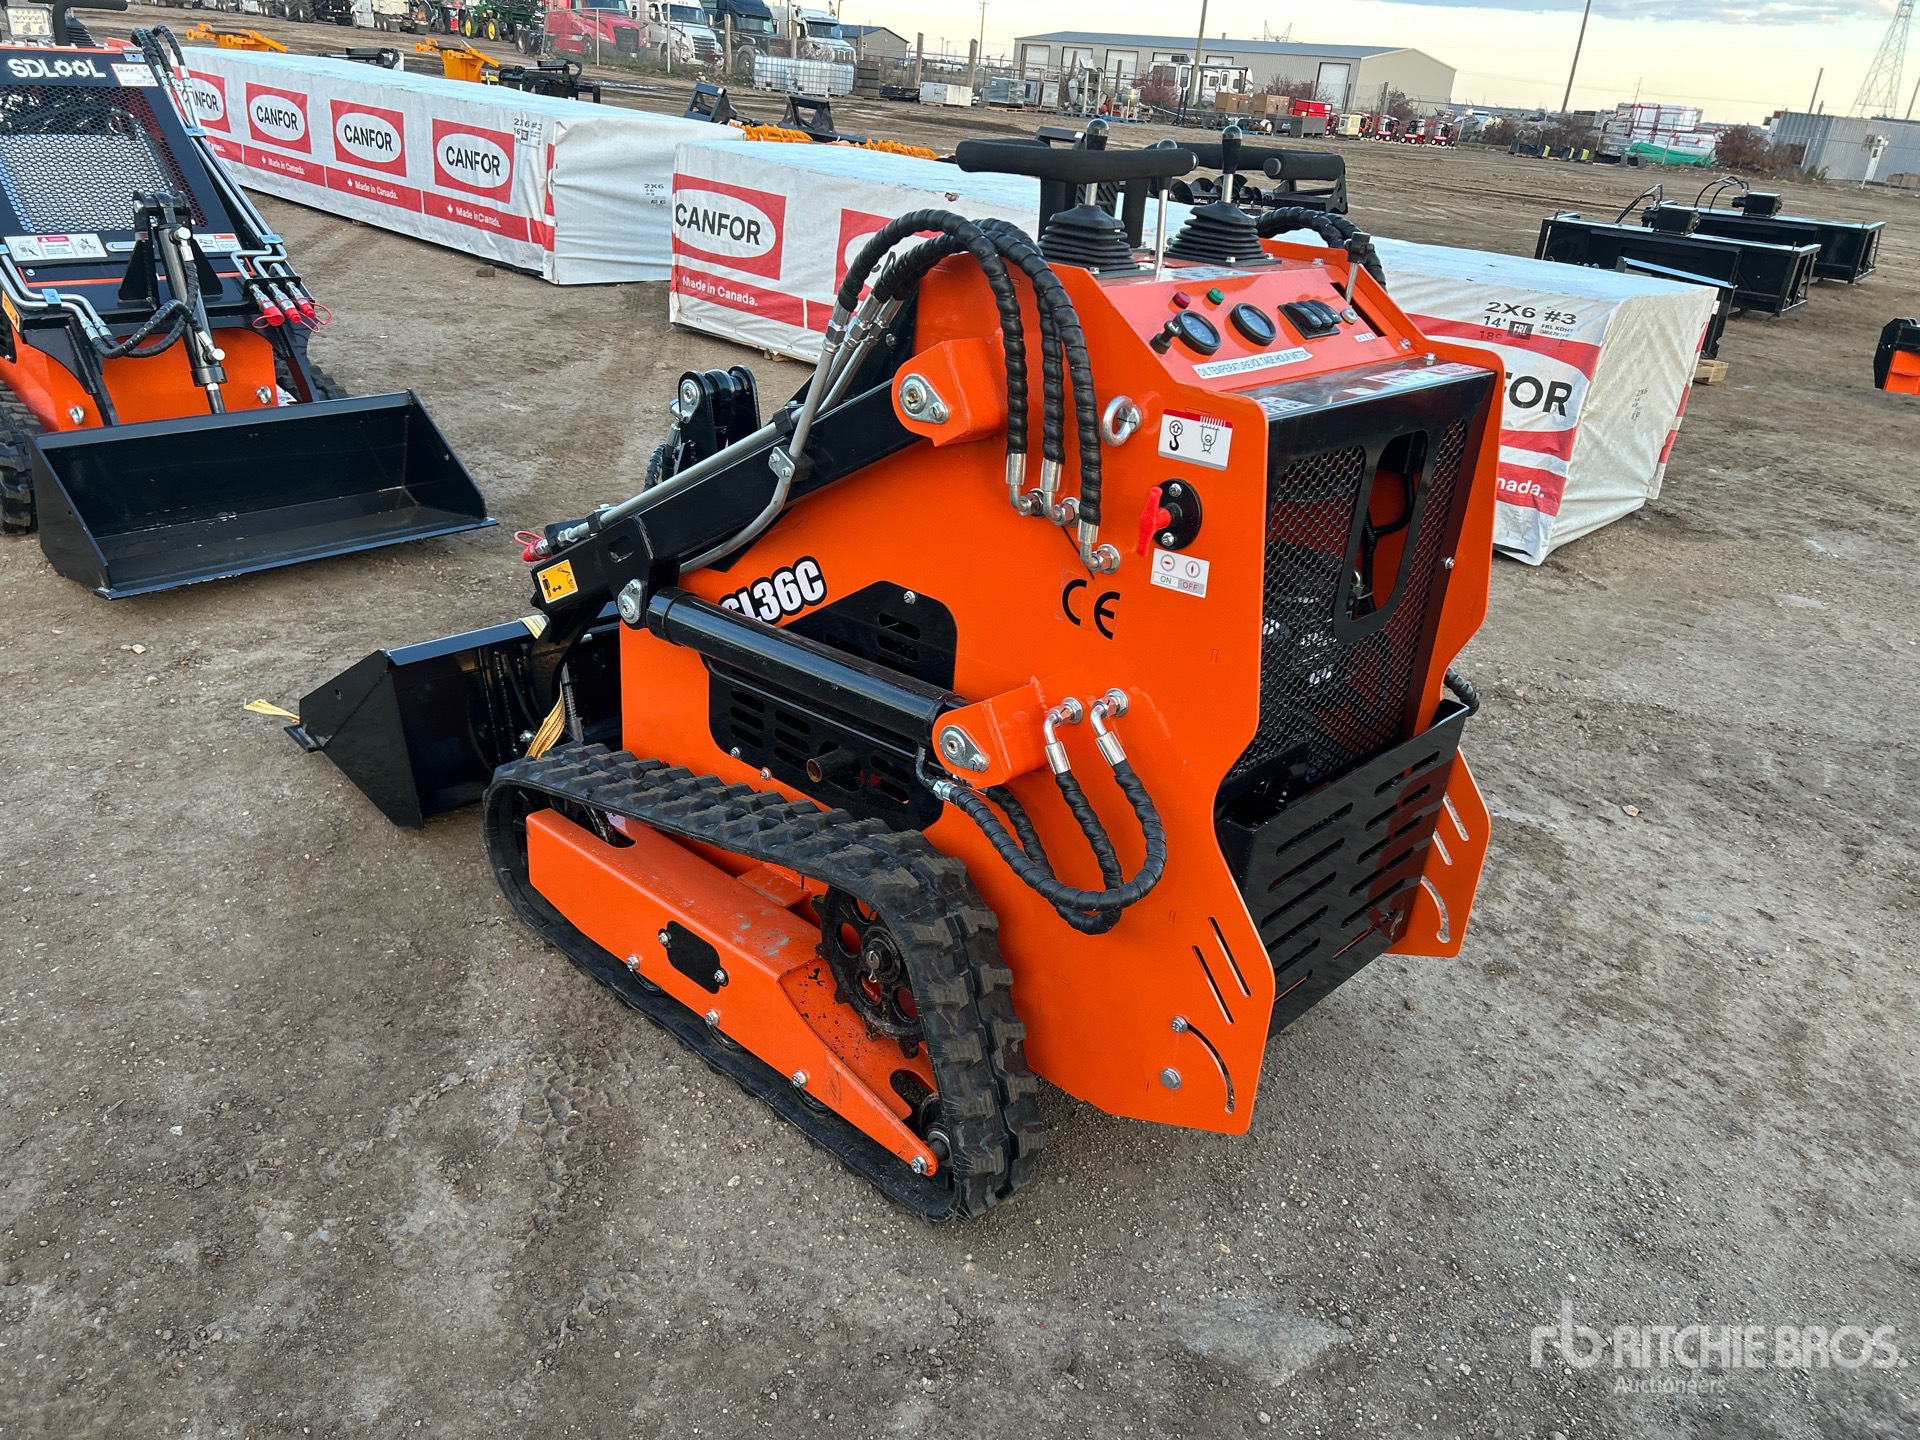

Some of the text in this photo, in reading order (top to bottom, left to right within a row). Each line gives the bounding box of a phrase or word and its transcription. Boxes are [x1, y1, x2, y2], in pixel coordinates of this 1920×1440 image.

[7, 58, 107, 78] SDLOOL
[256, 105, 299, 131] CANFOR
[343, 124, 393, 152] CANFOR
[445, 145, 501, 176] CANFOR
[354, 180, 370, 193] Made
[369, 183, 376, 194] in
[455, 206, 502, 228] Made in Canada.
[675, 202, 761, 246] CANFOR
[682, 275, 758, 307] Made in Canada.
[1483, 315, 1507, 328] 14'
[1485, 301, 1577, 325] 2X6 #3
[1160, 575, 1198, 591] ON OFF
[1062, 578, 1121, 641] CE
